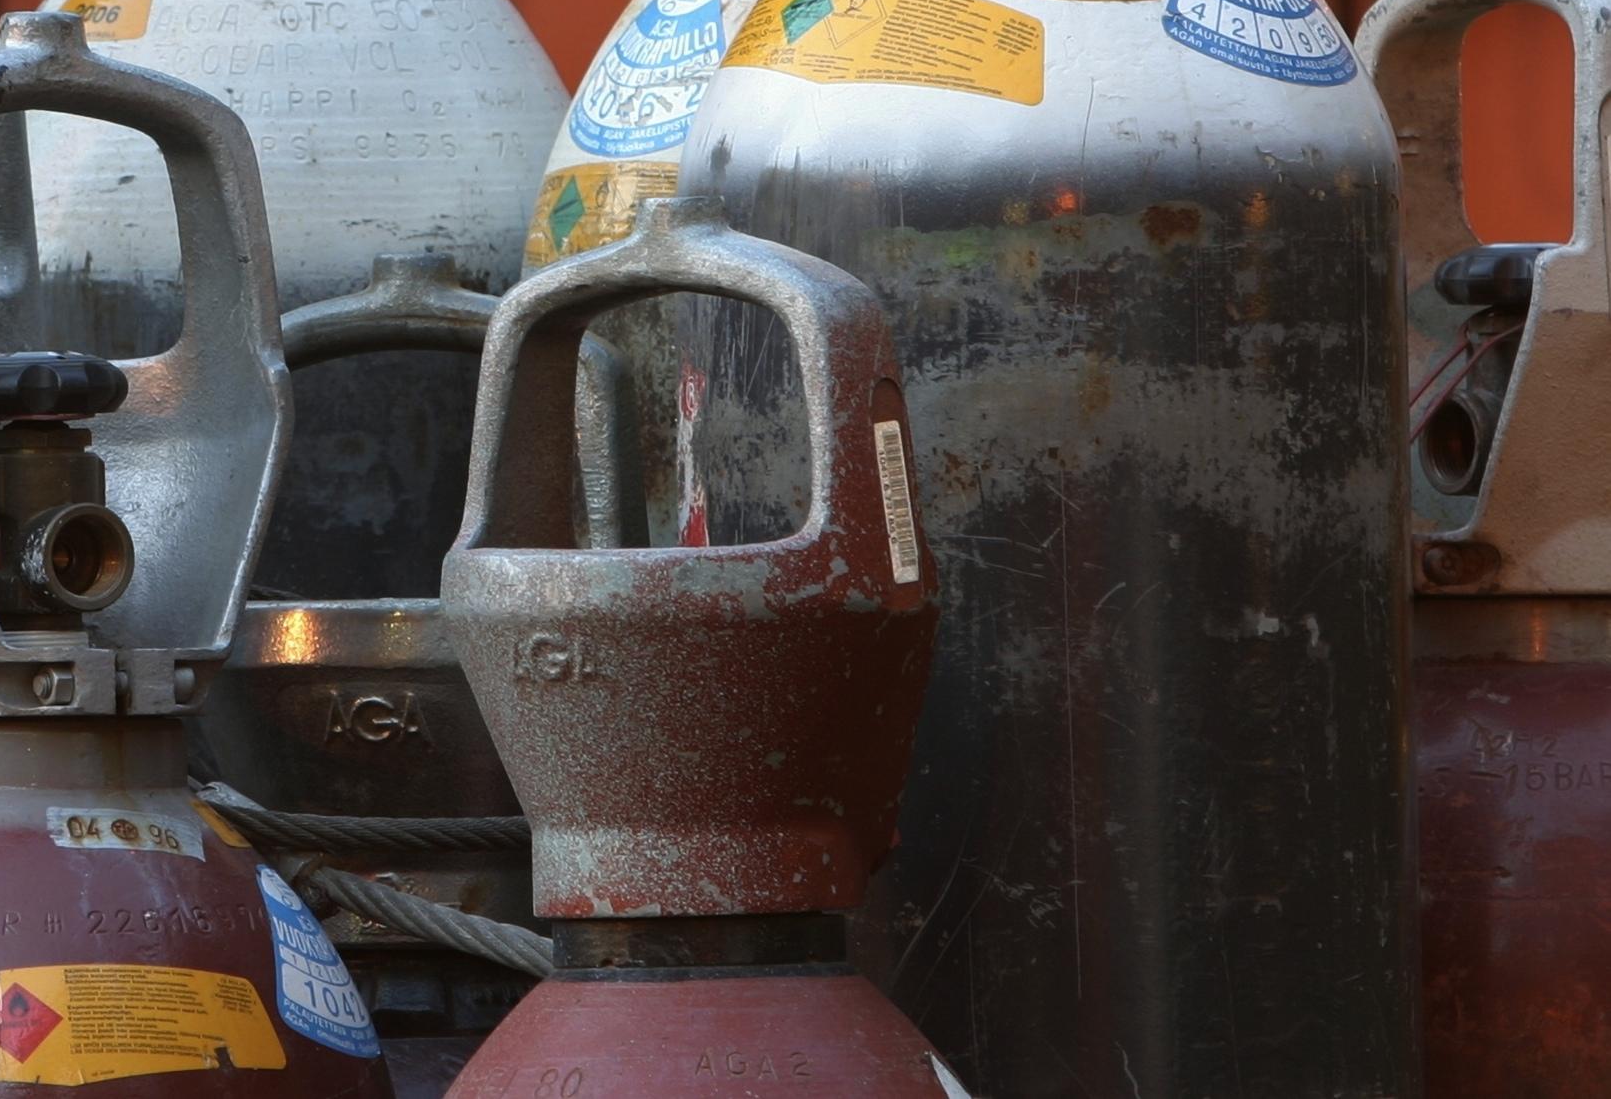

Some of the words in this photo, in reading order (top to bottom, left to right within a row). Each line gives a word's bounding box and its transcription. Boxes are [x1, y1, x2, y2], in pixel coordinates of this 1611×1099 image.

[1191, 2, 1206, 22] 4
[1231, 17, 1246, 40] 2
[1268, 29, 1284, 50] 0
[1297, 32, 1313, 54] 9
[324, 689, 433, 745] AGA
[67, 816, 102, 840] 04
[149, 824, 180, 849] 96
